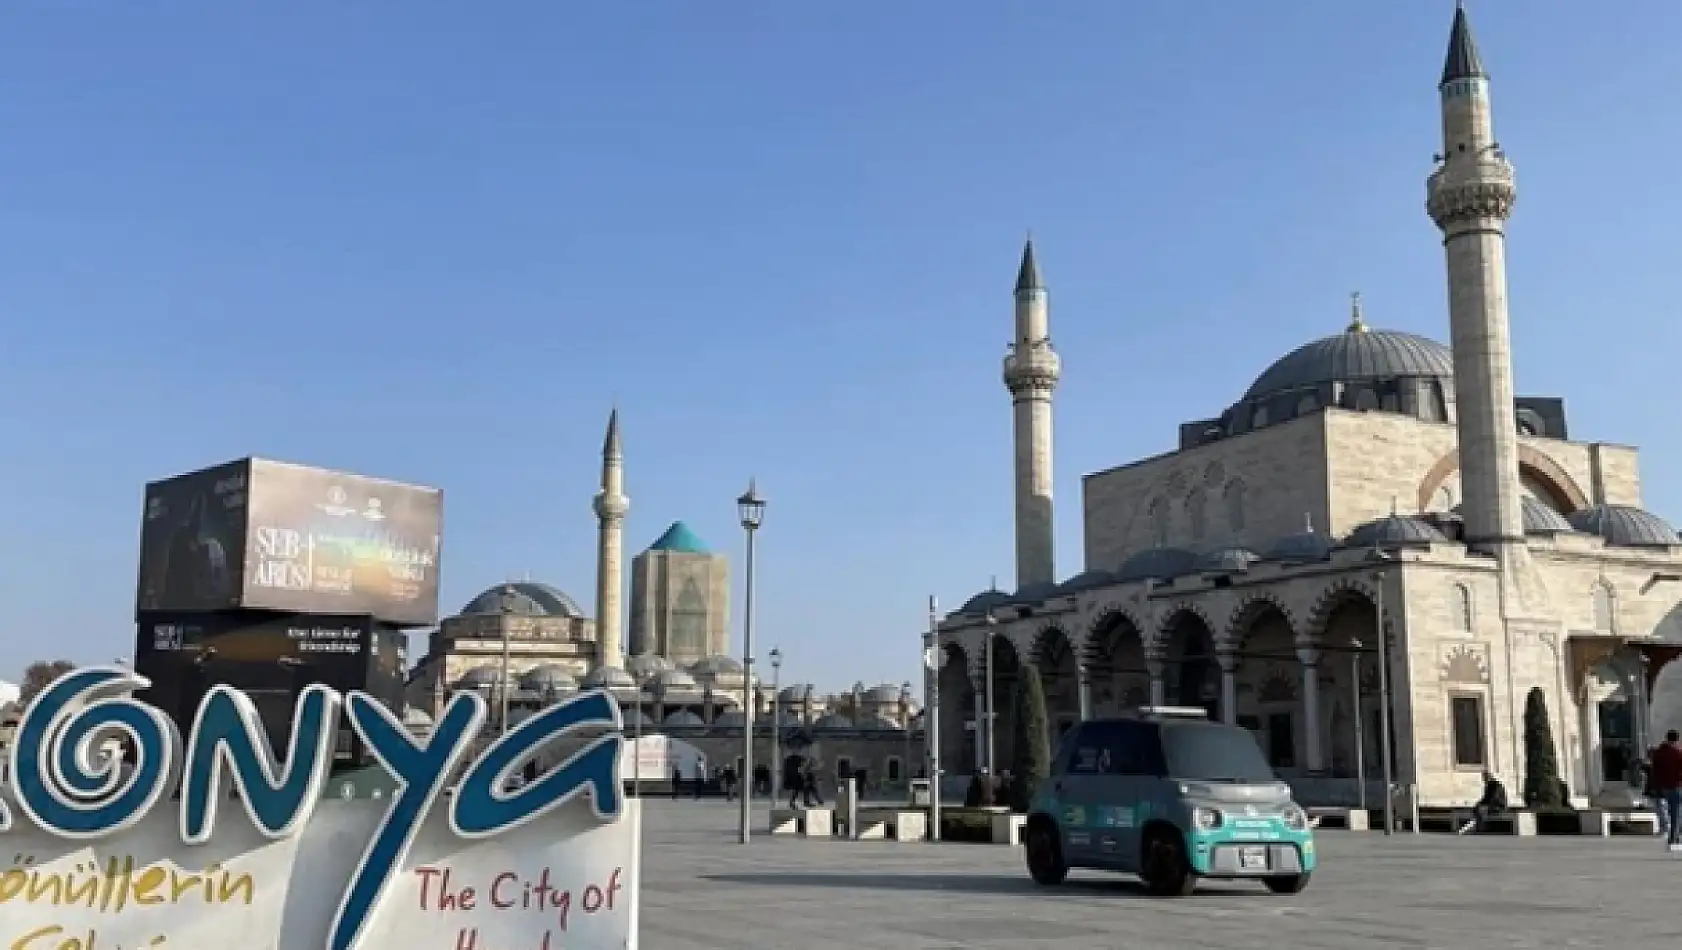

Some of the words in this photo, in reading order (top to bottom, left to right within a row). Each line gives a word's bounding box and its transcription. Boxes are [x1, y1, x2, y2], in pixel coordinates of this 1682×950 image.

[0, 667, 623, 950] ONYA
[414, 866, 476, 911] The
[489, 866, 571, 931] City
[581, 866, 622, 913] of
